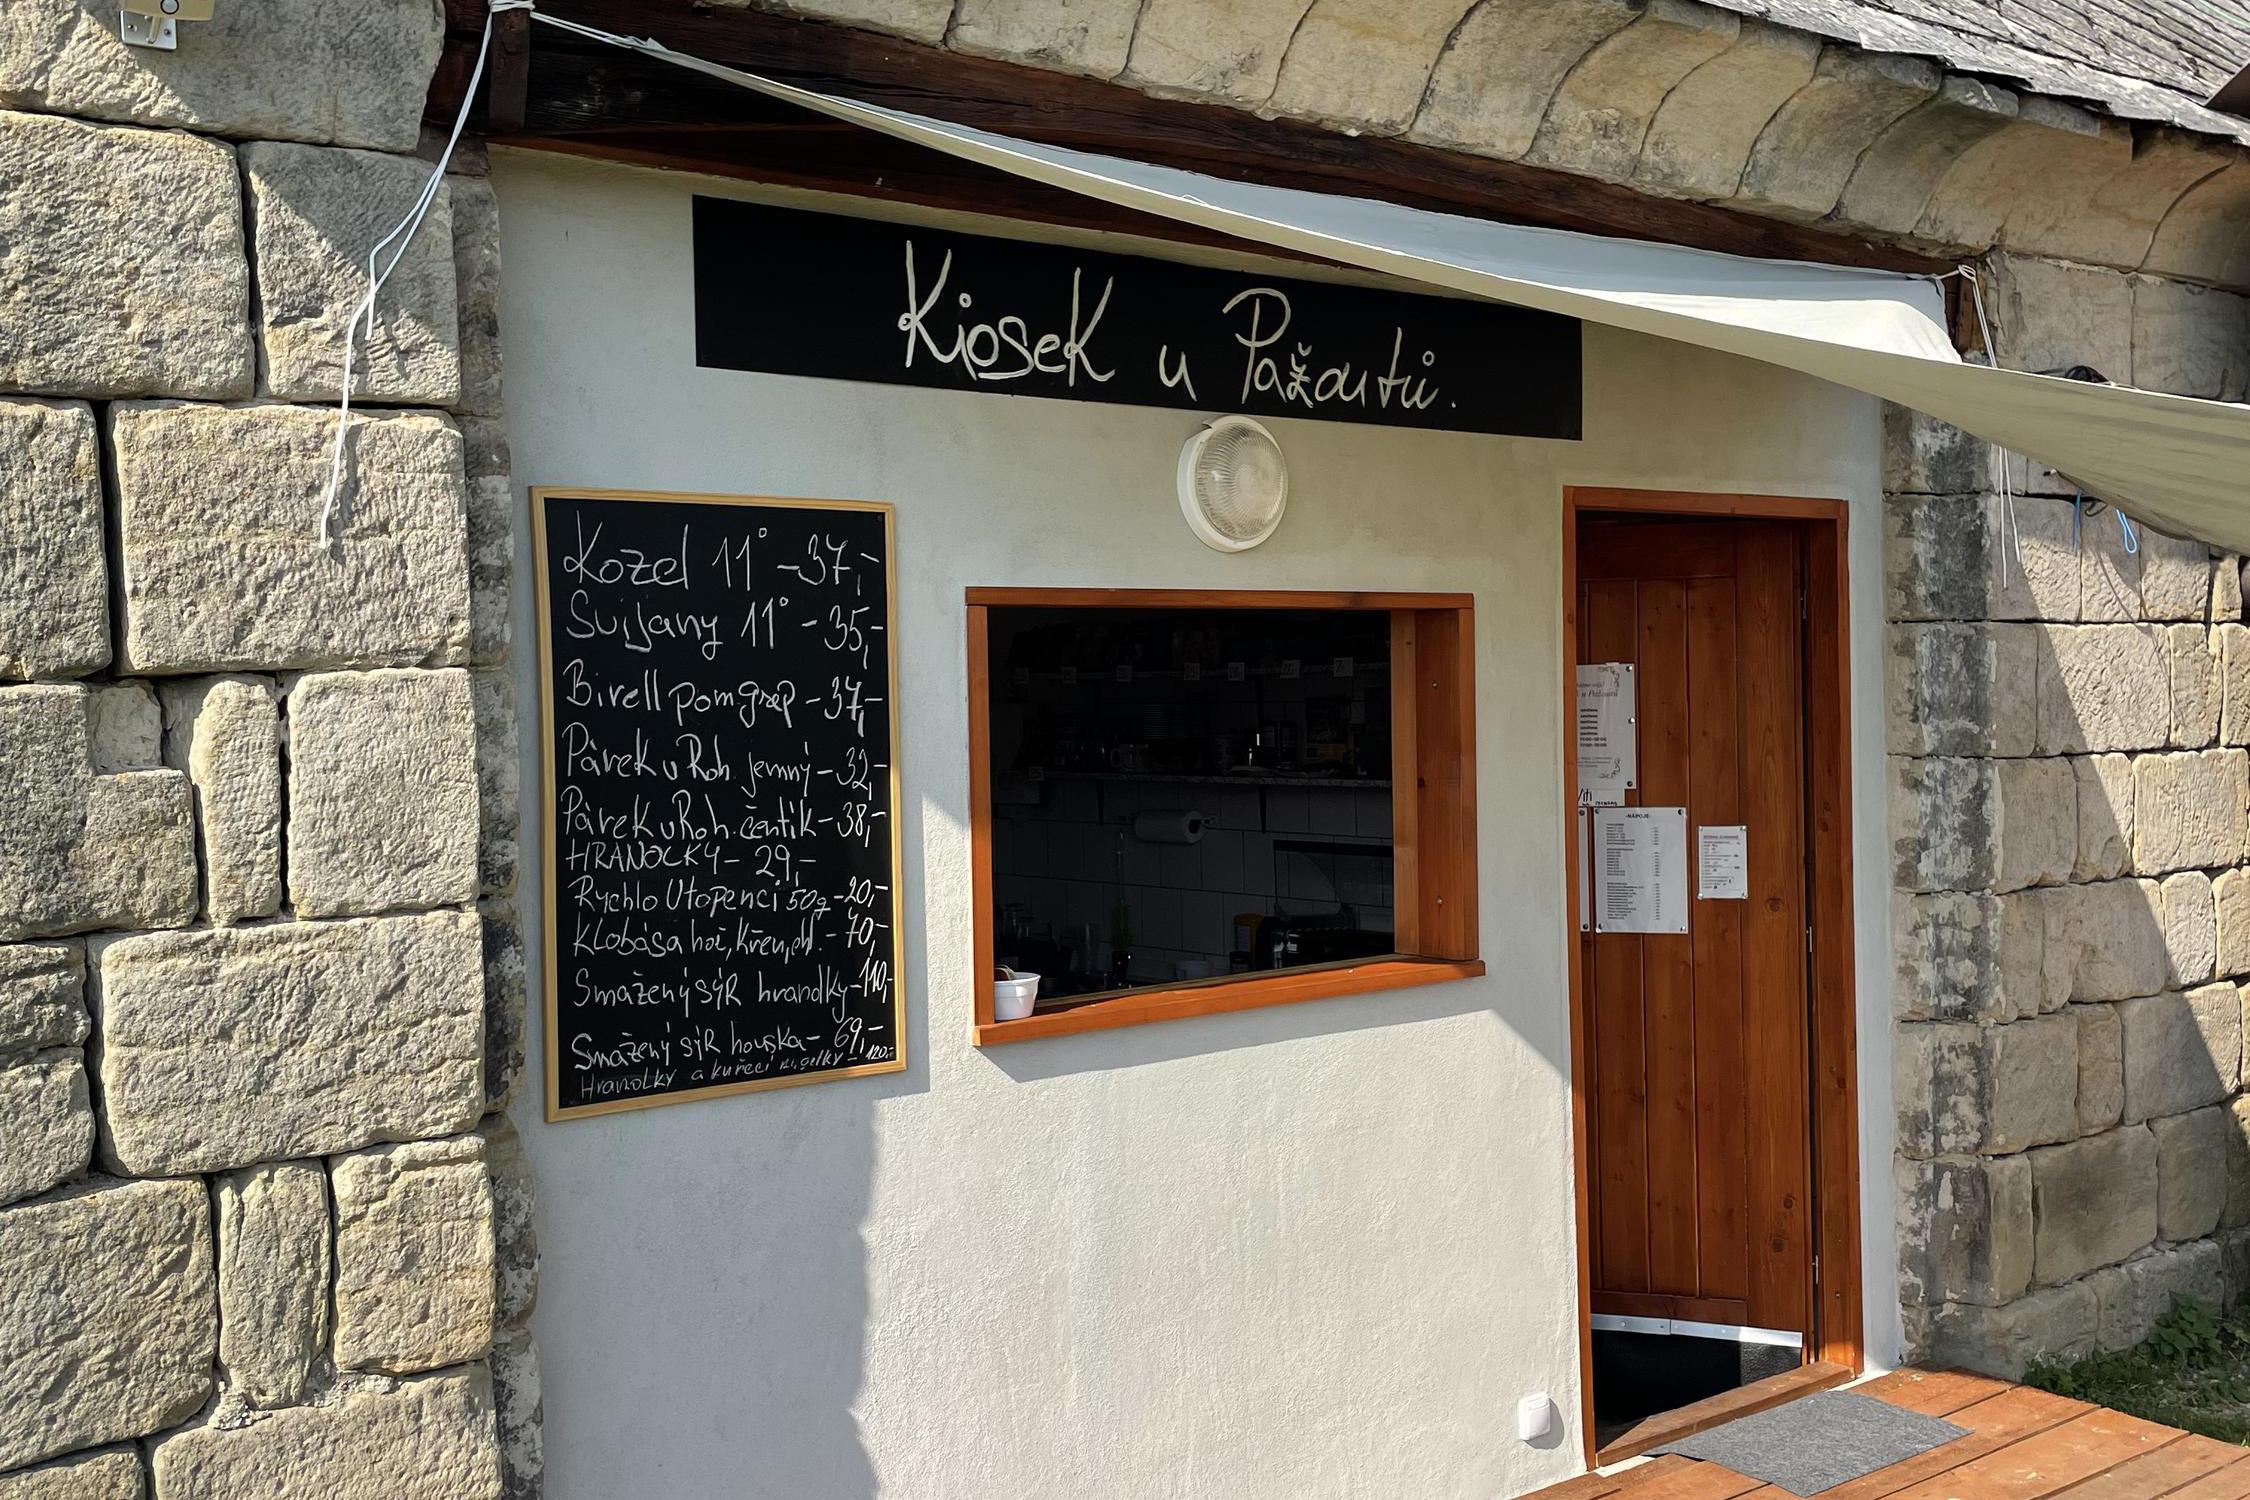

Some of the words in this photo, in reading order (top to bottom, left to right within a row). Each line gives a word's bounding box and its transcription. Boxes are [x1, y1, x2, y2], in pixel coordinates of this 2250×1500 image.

[1159, 345, 1198, 402] u
[563, 510, 689, 590] Kozel
[712, 527, 768, 592] 11°
[741, 596, 789, 649] 11°
[563, 658, 661, 711] Birell
[574, 967, 690, 1018] Smažený
[571, 1021, 671, 1071] Smažený
[691, 1069, 704, 1081] a
